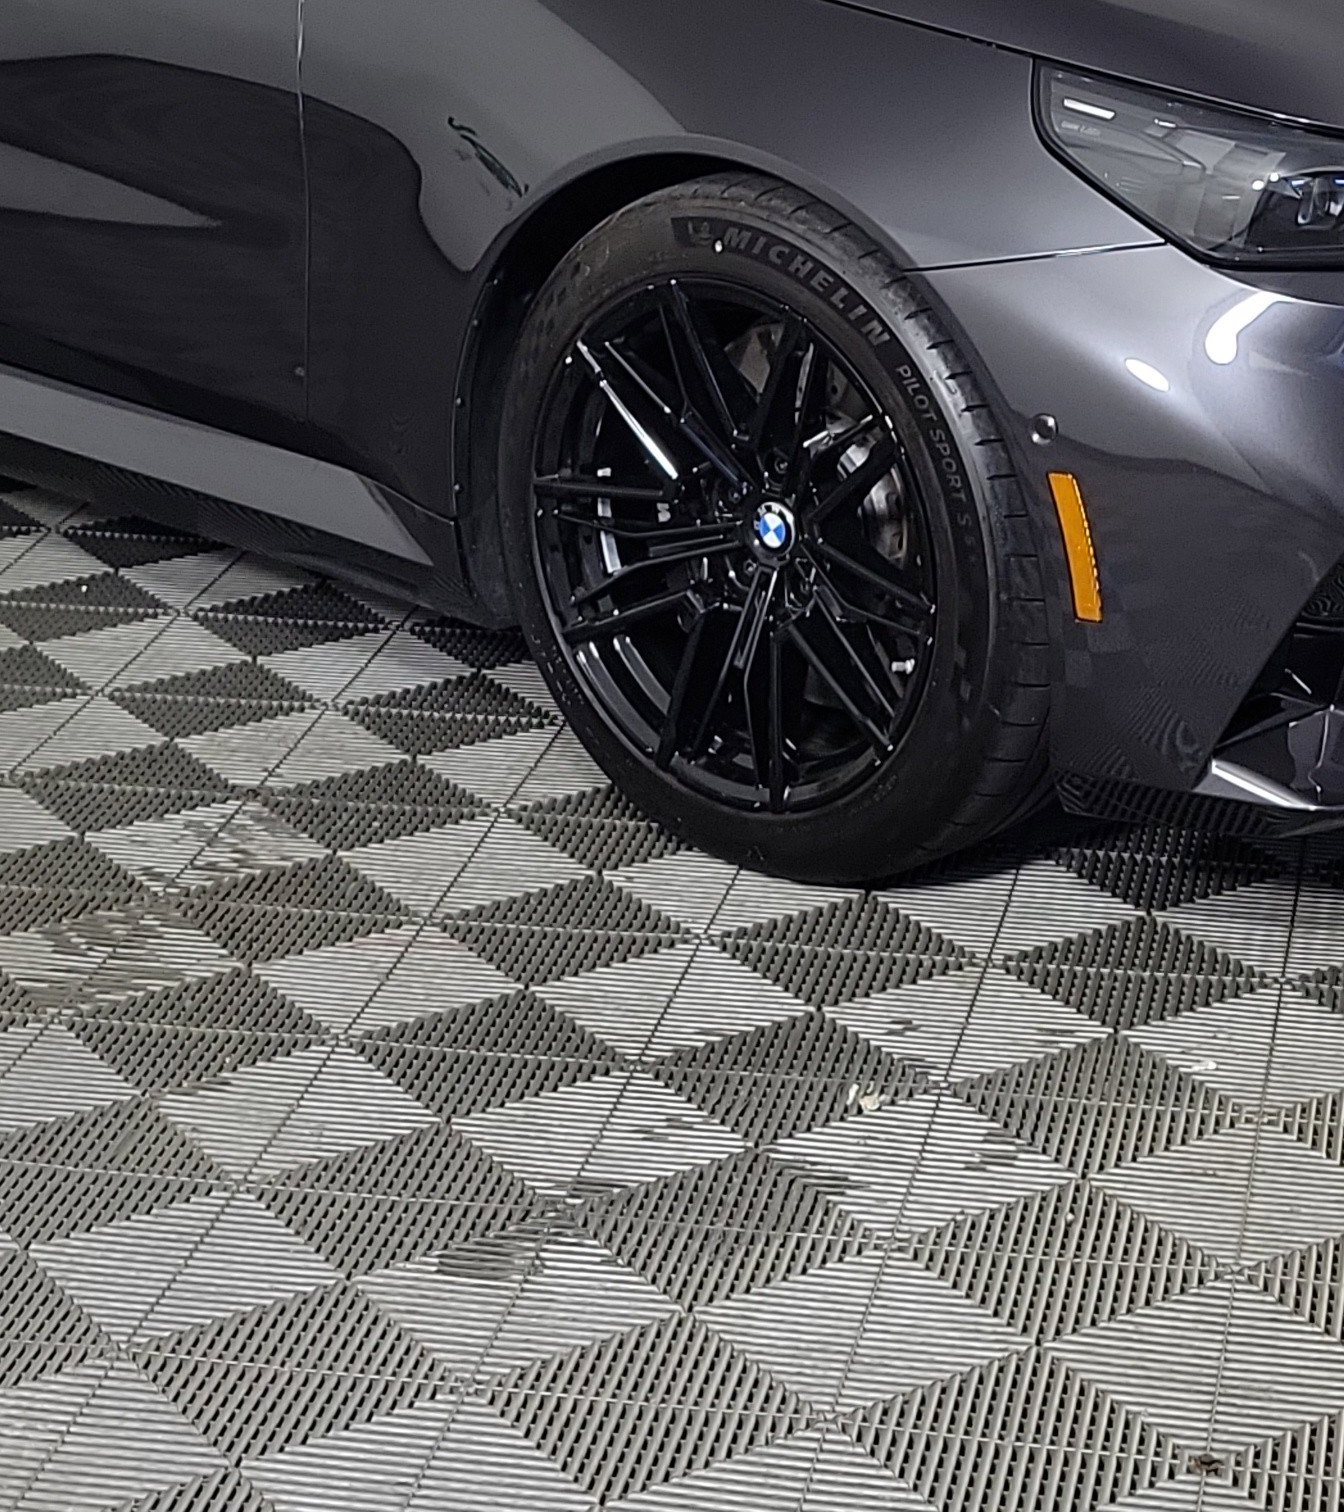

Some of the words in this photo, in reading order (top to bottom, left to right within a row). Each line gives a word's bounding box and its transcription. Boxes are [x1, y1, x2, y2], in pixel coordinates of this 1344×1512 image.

[722, 226, 892, 348] MICHELIN
[895, 364, 937, 421] PILOT
[929, 428, 968, 503] SPORT
